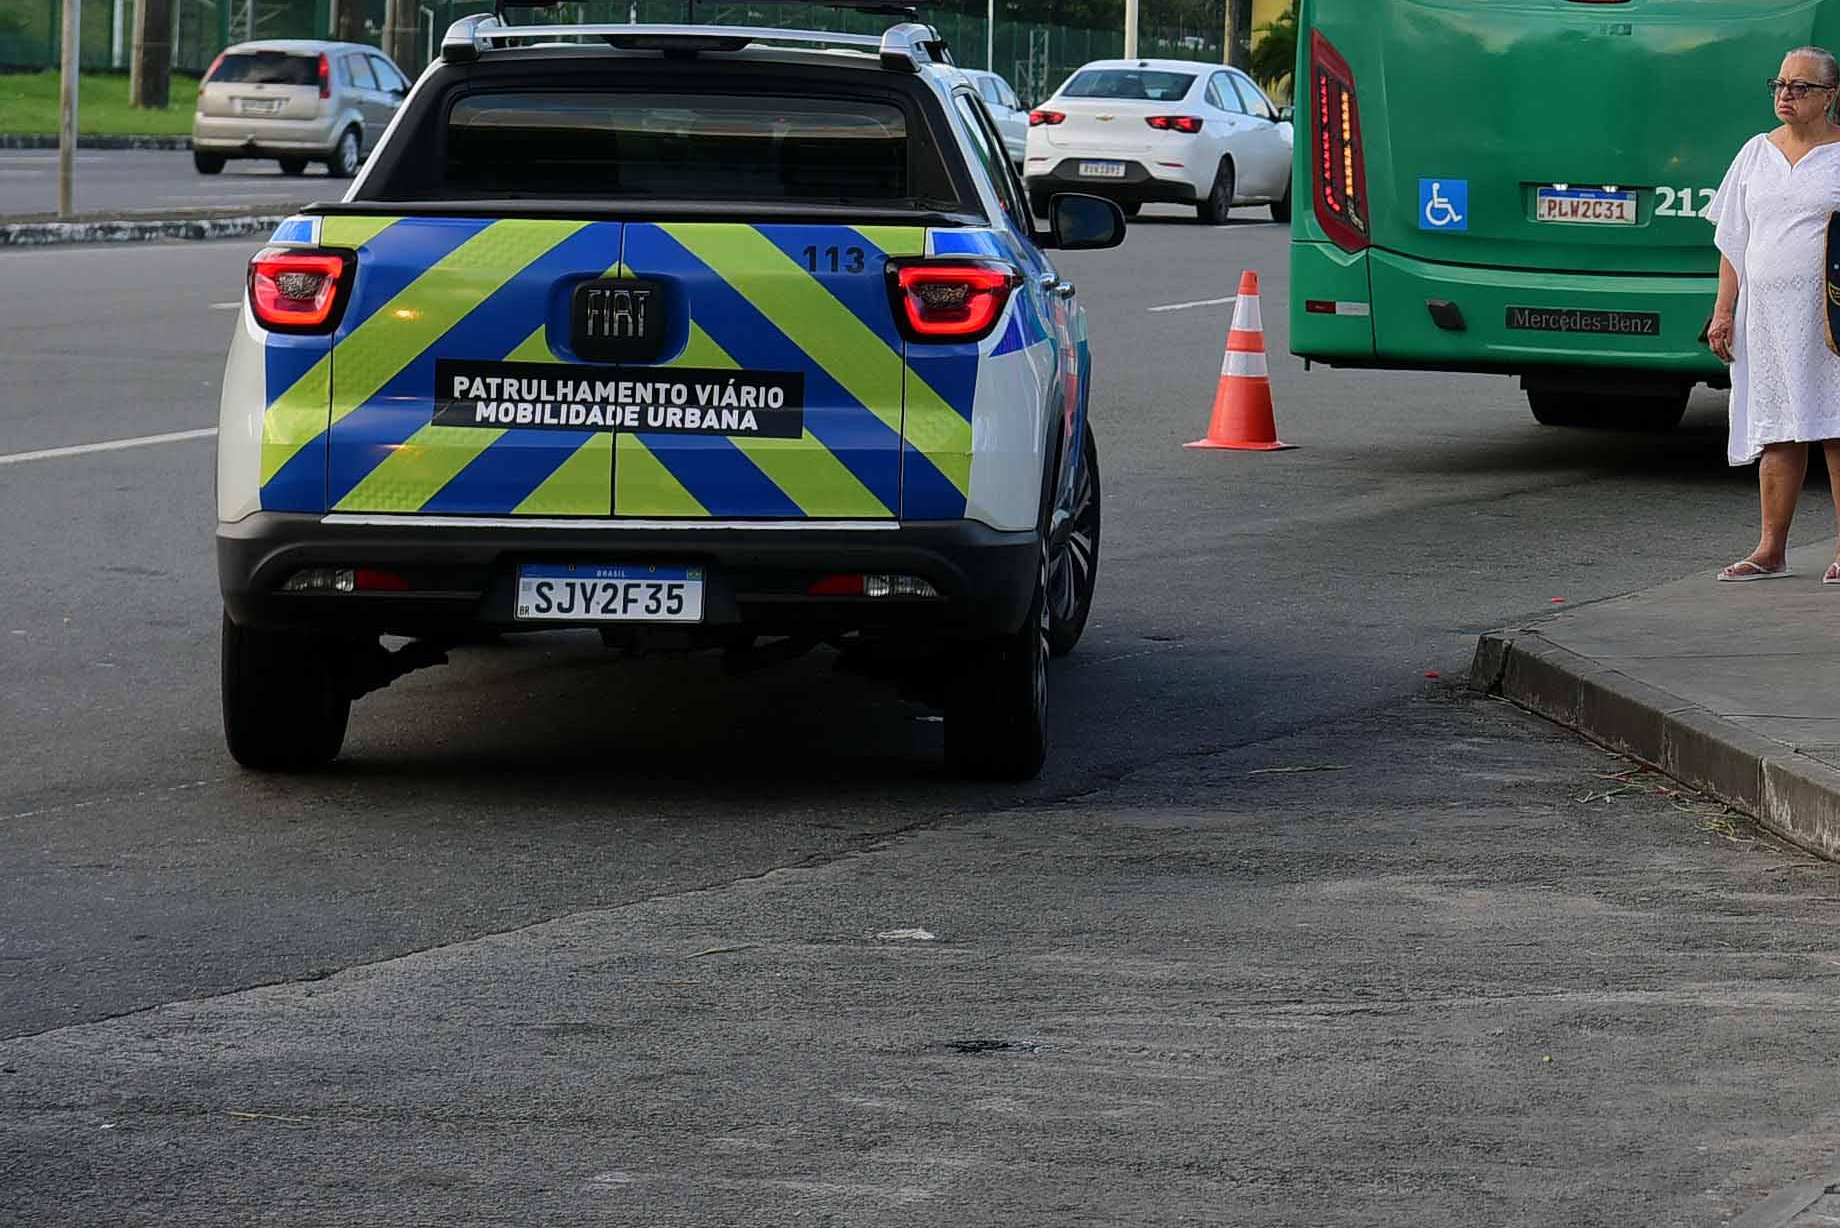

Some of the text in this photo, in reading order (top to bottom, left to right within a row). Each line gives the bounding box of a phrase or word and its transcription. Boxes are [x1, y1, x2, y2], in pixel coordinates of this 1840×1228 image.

[1546, 199, 1627, 221] PLW2C31
[802, 244, 866, 274] 113
[586, 289, 651, 338] FIAT
[1513, 308, 1653, 334] Mercedes-Benz
[453, 375, 785, 409] PATRULHAMENTO VIÁRIO
[474, 401, 759, 432] MOBILIDADE URBANA
[596, 569, 626, 578] BRASIL
[534, 580, 686, 616] SJY2F35
